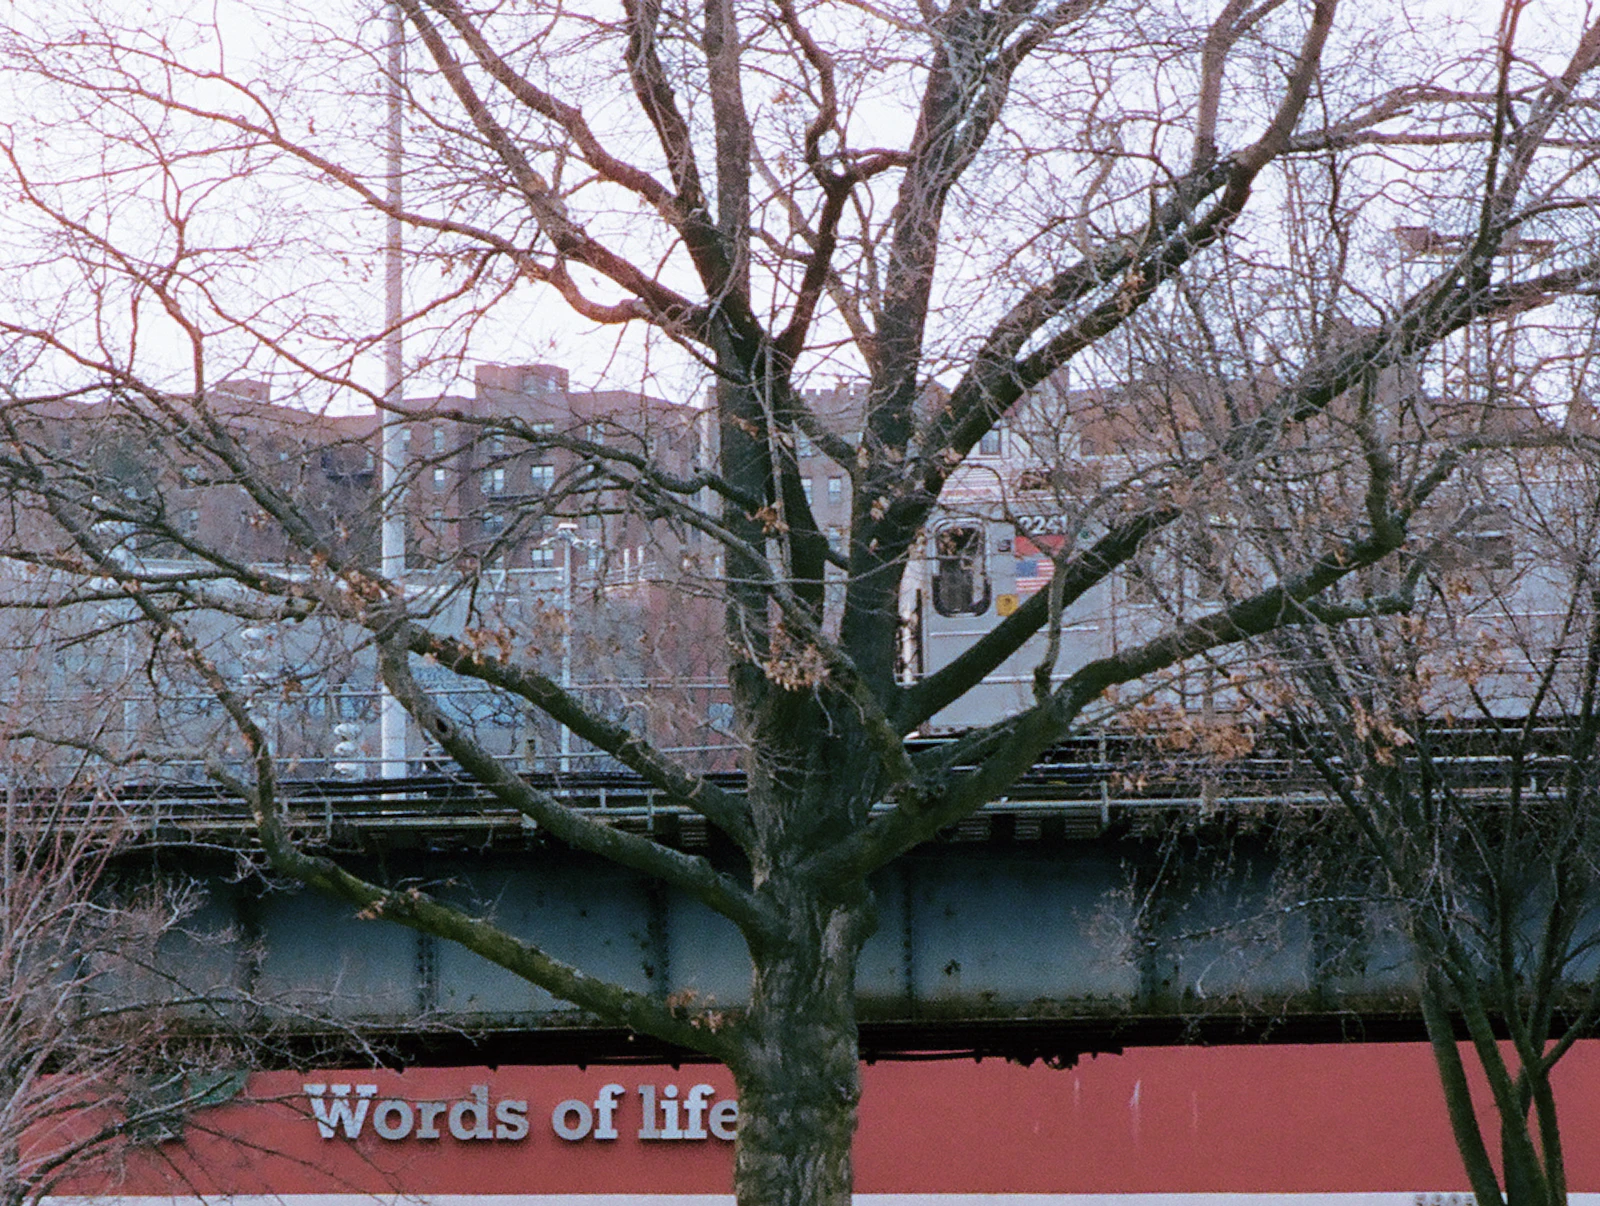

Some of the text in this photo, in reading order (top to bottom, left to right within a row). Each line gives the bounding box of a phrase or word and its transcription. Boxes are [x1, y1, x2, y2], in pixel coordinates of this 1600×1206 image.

[303, 1084, 738, 1140] Words of life
